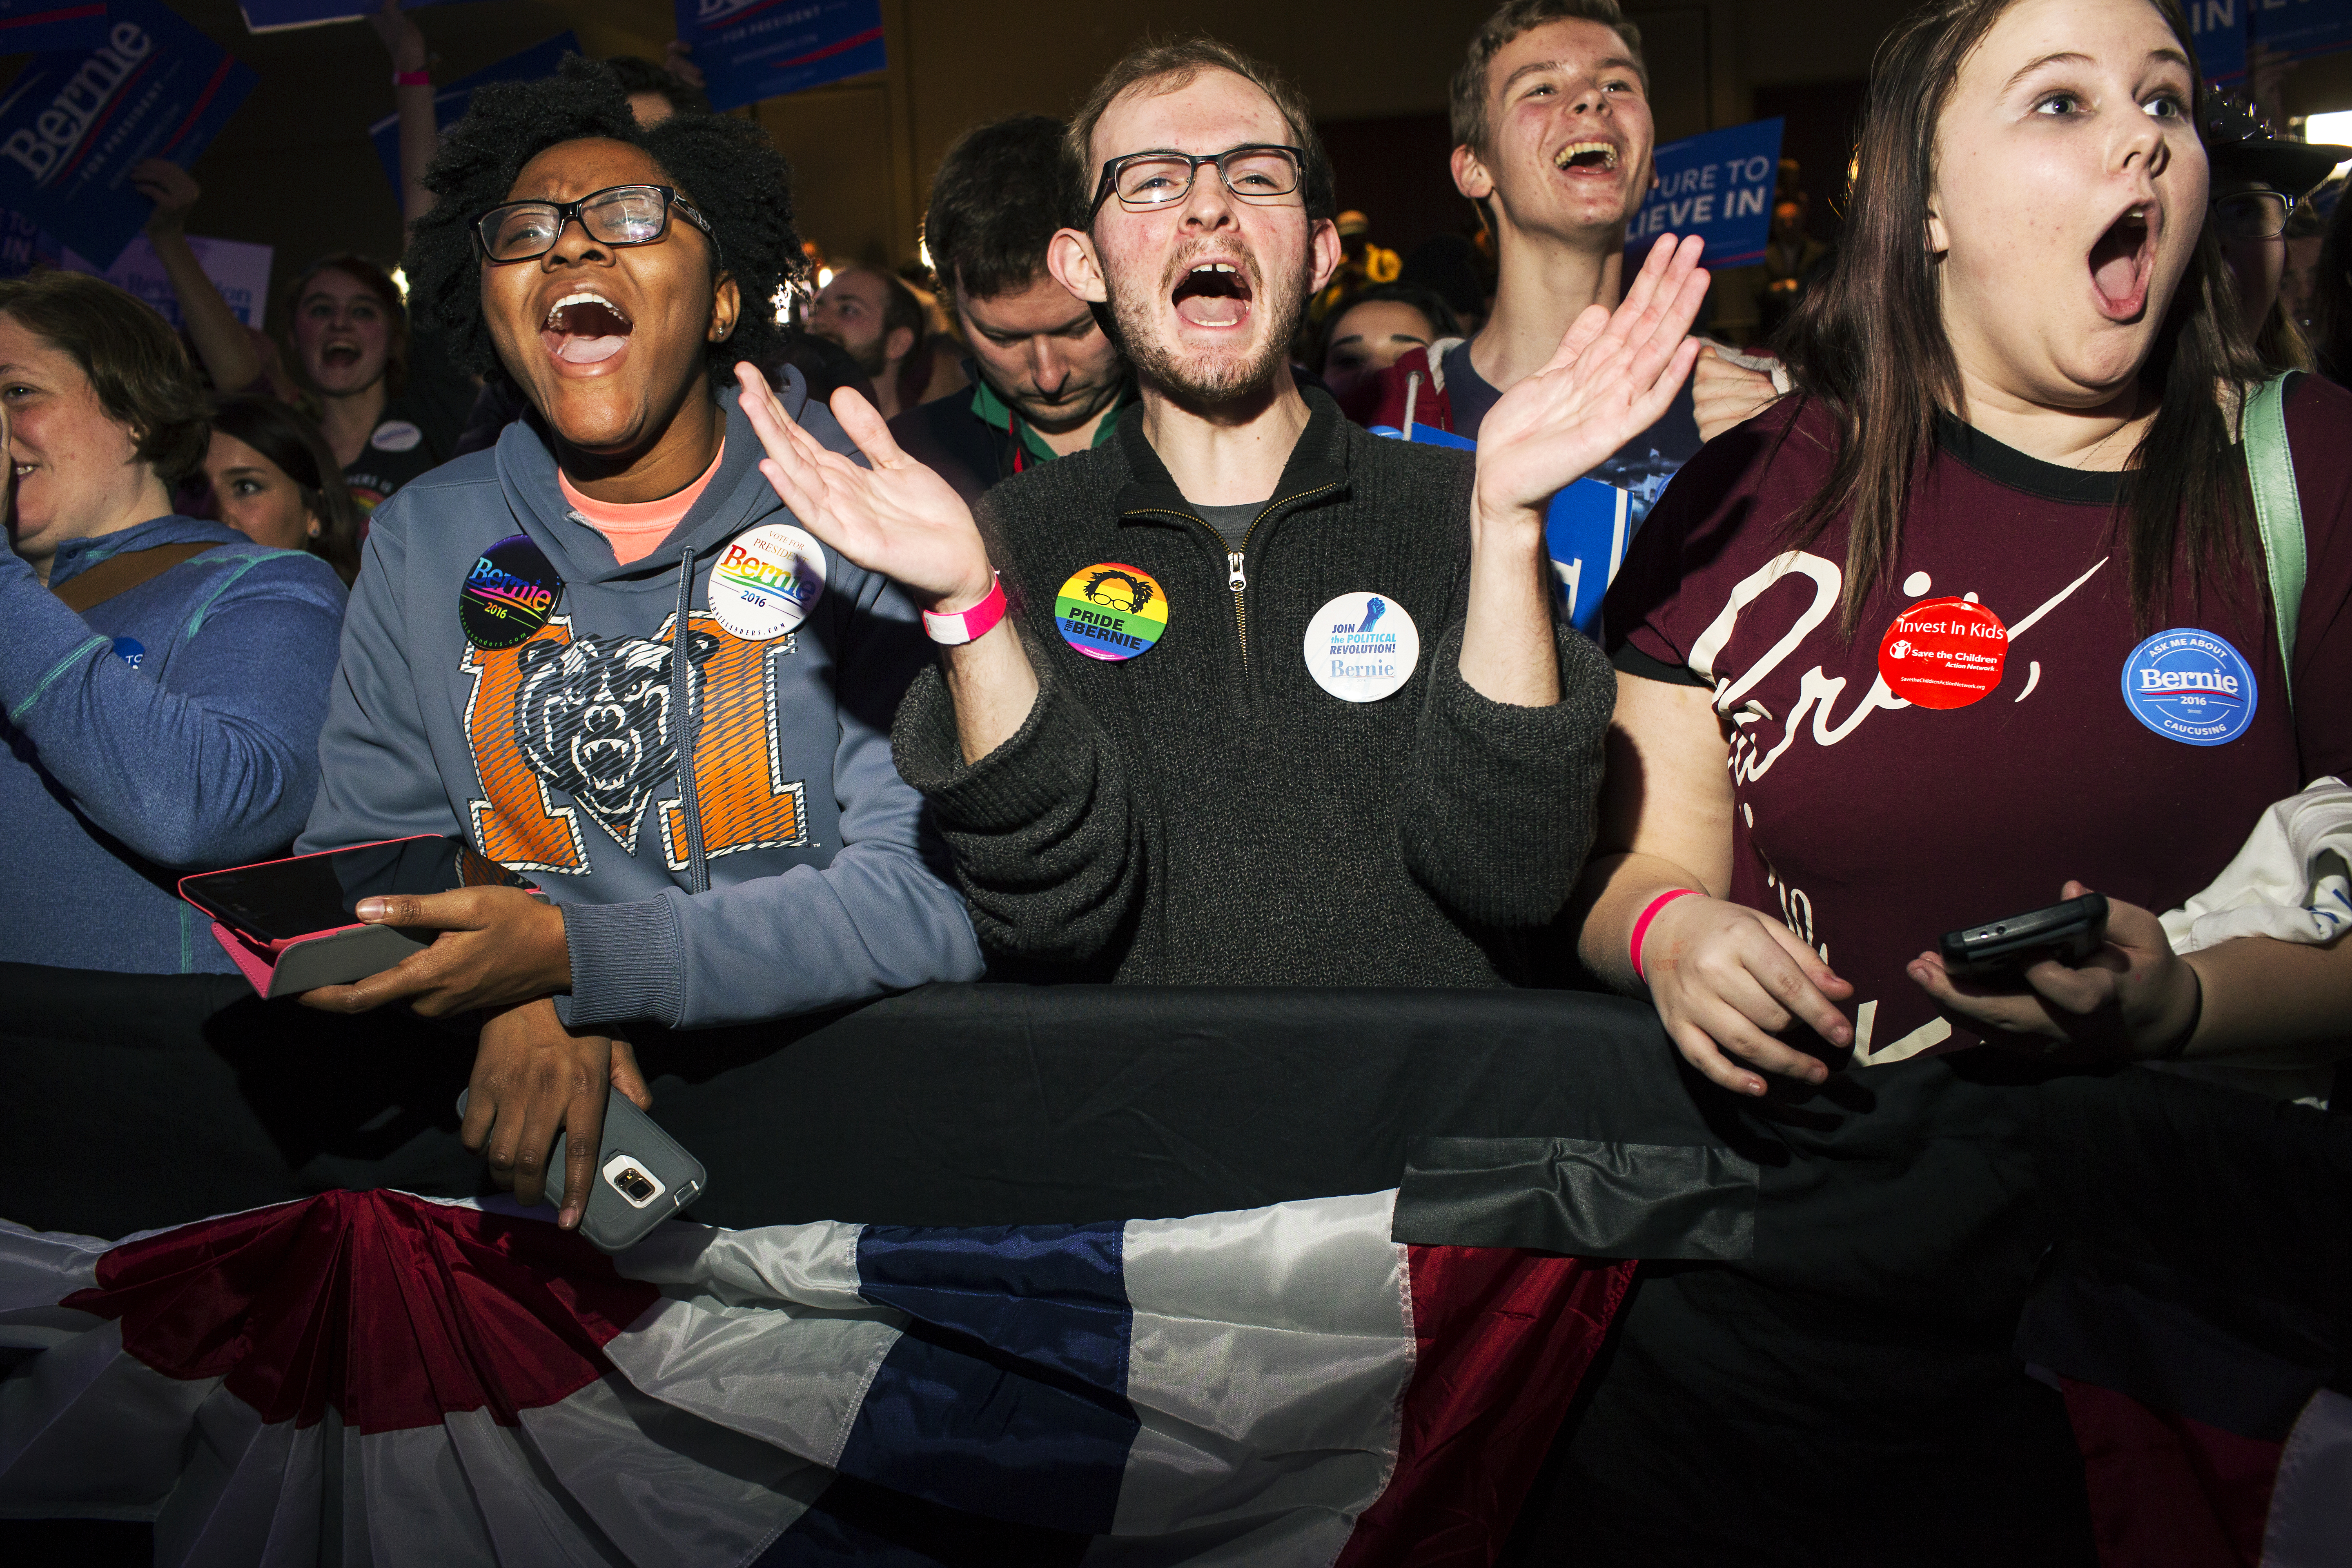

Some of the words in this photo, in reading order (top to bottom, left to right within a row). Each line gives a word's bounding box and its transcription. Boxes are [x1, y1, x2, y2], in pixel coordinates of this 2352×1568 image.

[1, 20, 153, 180] Bernie
[1724, 155, 1769, 185] TO
[1723, 185, 1767, 219] IN
[769, 531, 789, 543] VOTE
[789, 539, 804, 550] FOR
[753, 538, 809, 565] PRESIDENT
[720, 544, 816, 601] Bernie
[469, 557, 551, 611] Bernie
[740, 590, 767, 607] 2016
[484, 602, 508, 619] 2016
[709, 597, 785, 636] BERNIESANDERS.COM
[1069, 607, 1125, 631] PRIDE
[459, 605, 526, 646] berniesanders.com
[1064, 620, 1074, 631] FOR
[1072, 621, 1143, 650] BERNIE
[1332, 624, 1355, 633] JOIN
[1897, 618, 1947, 633] Invest
[1951, 621, 1965, 635] In
[1970, 623, 2004, 639] Kids
[1331, 635, 1344, 644] the
[1347, 633, 1396, 644] POLITICAL
[2149, 642, 2169, 658] ASK
[2169, 638, 2188, 647] ME
[2189, 638, 2227, 658] ABOUT
[1330, 644, 1396, 655] REVOLUTION!
[1912, 649, 1934, 658] Save
[1936, 651, 1953, 659] the
[1955, 653, 1997, 664] Children
[1330, 659, 1394, 677] Bernie
[1901, 677, 1985, 690] SavetheChildrenActionNetwork.org
[2140, 668, 2238, 693] Bernie
[2180, 696, 2207, 706] 2016
[2164, 719, 2227, 735] CAUCUSING
